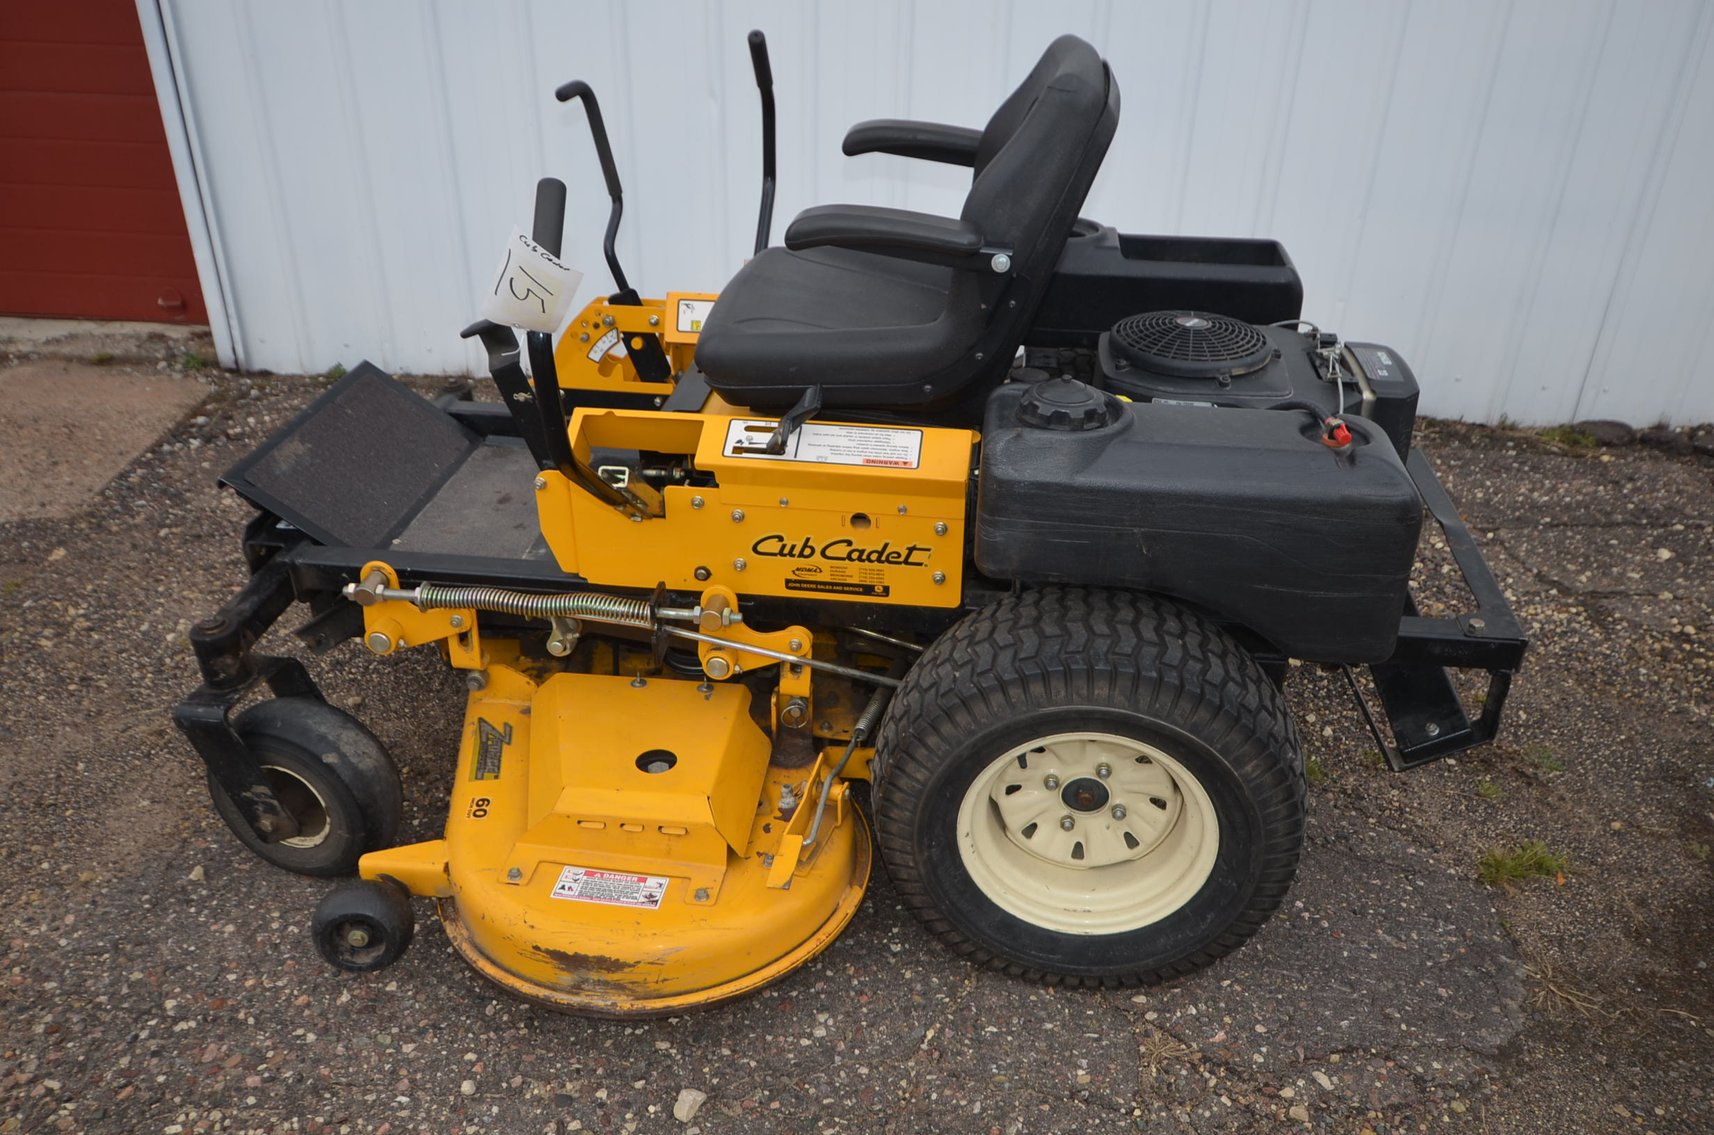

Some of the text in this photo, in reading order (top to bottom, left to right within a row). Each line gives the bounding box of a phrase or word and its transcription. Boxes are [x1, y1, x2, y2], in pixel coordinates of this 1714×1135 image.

[751, 534, 933, 567] Cub Cadet
[472, 797, 491, 819] 60
[603, 873, 638, 882] DANGER
